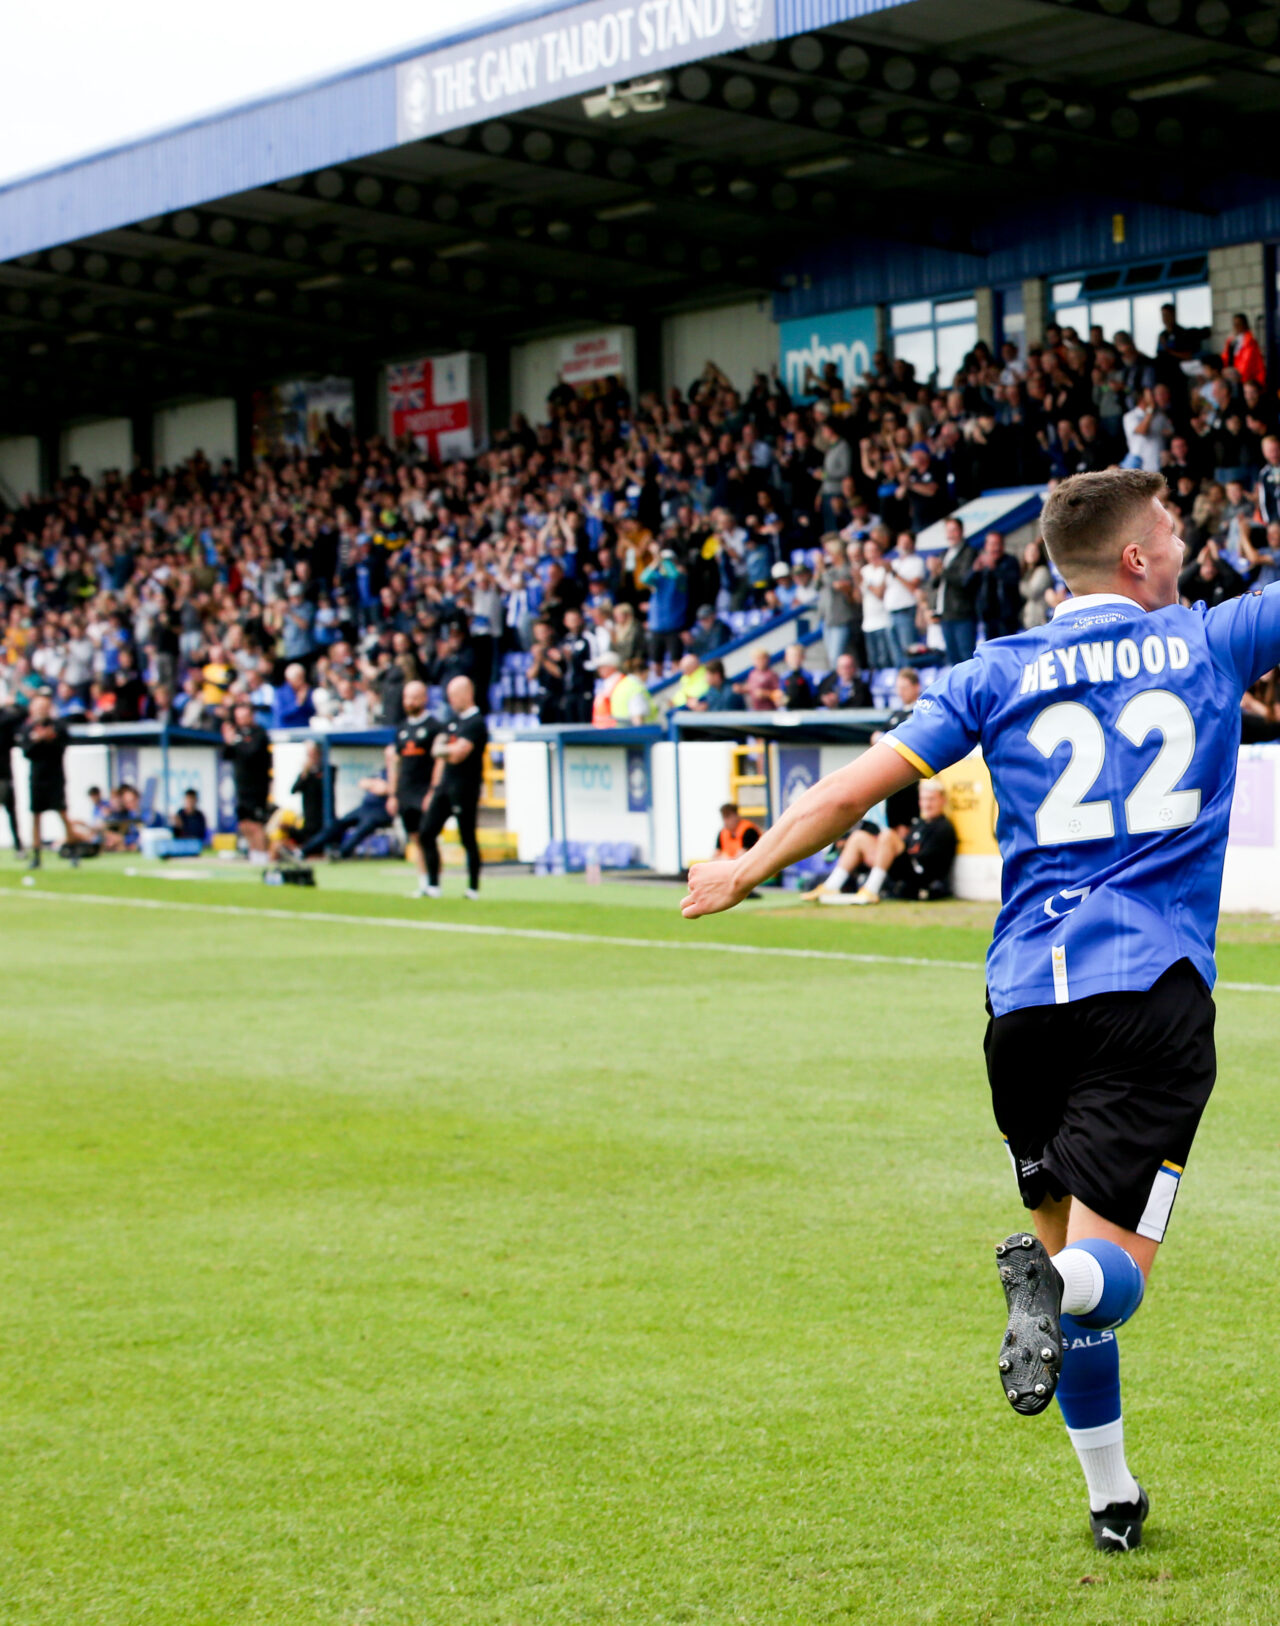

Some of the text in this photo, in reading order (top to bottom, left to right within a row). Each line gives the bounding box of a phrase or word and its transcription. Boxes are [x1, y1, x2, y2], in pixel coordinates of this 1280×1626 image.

[432, 0, 727, 115] THE GARY TALBOT STAND
[1020, 634, 1190, 695] HEYWOOD
[1026, 688, 1202, 847] 22
